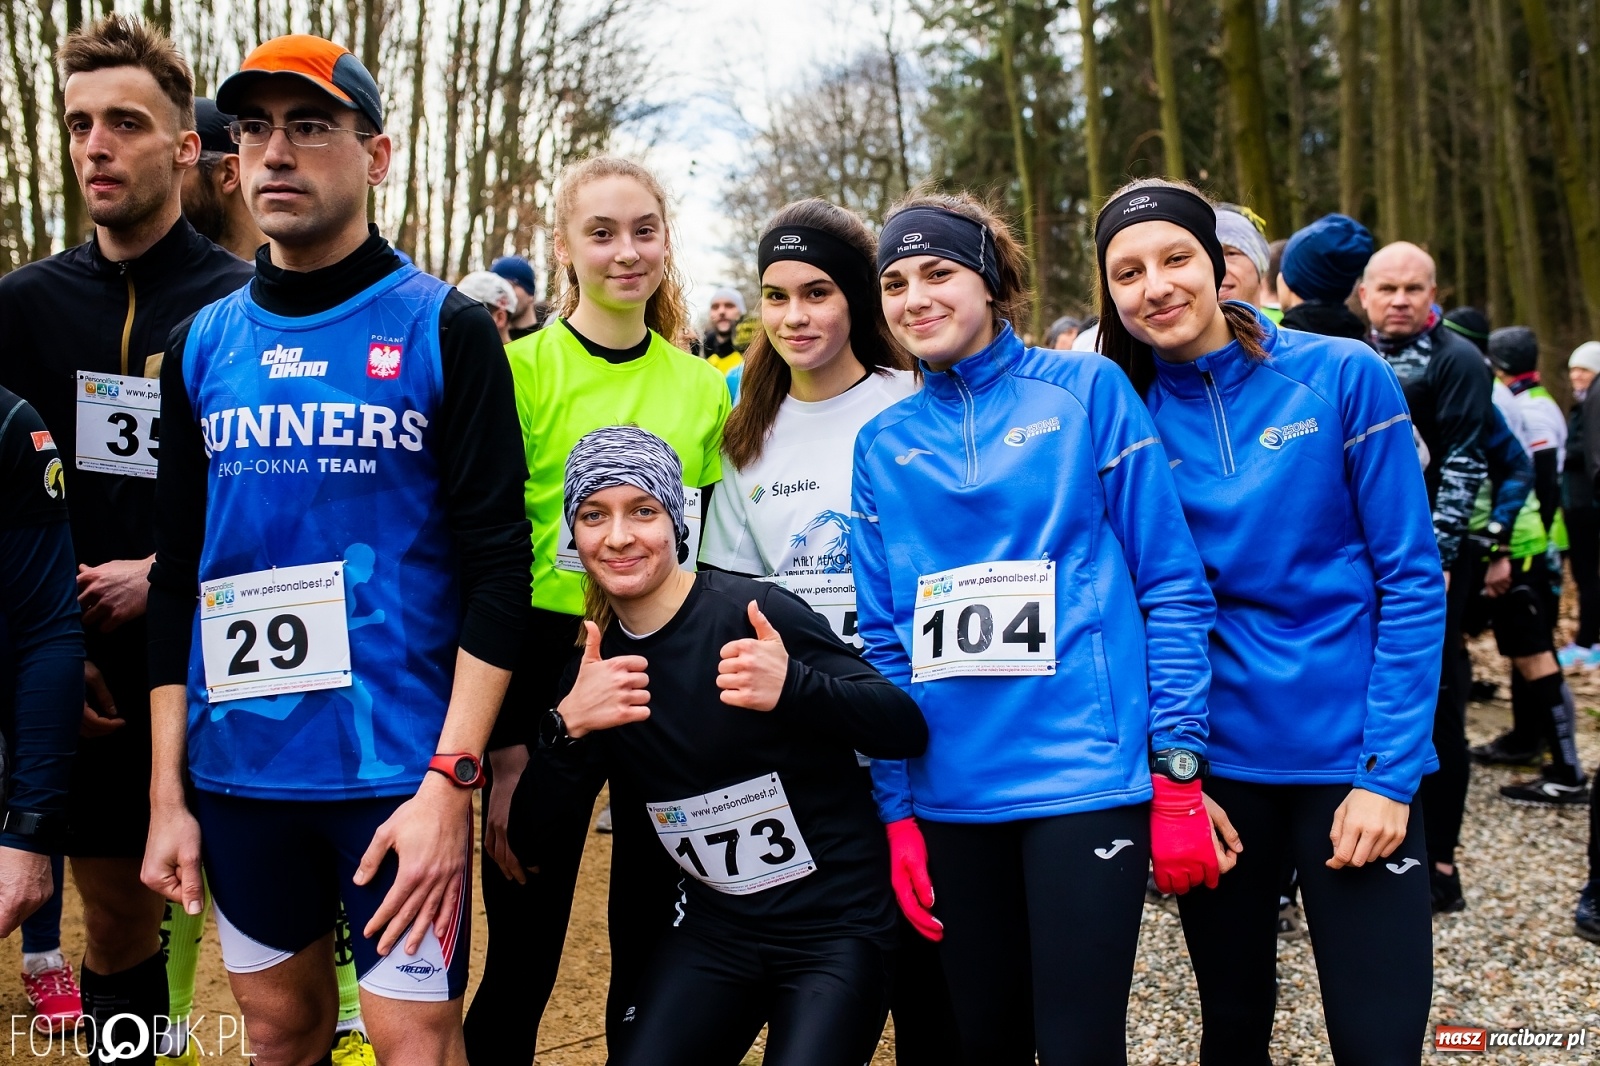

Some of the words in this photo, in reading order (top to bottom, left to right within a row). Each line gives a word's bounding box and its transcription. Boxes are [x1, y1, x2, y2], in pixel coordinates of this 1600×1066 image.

[1123, 202, 1158, 215] Kalenji
[773, 244, 808, 252] Kalenji
[897, 242, 930, 253] Kalenji
[200, 402, 429, 459] RUNNERS
[317, 458, 377, 474] TEAM
[772, 479, 820, 497] Śląskie.
[240, 576, 336, 597] www.personalbest.pl
[958, 573, 1048, 587] www.personalbest.pl
[922, 602, 1047, 659] 104
[226, 613, 309, 676] 29
[690, 786, 778, 818] www.personalbest.pl
[675, 818, 797, 878] 173
